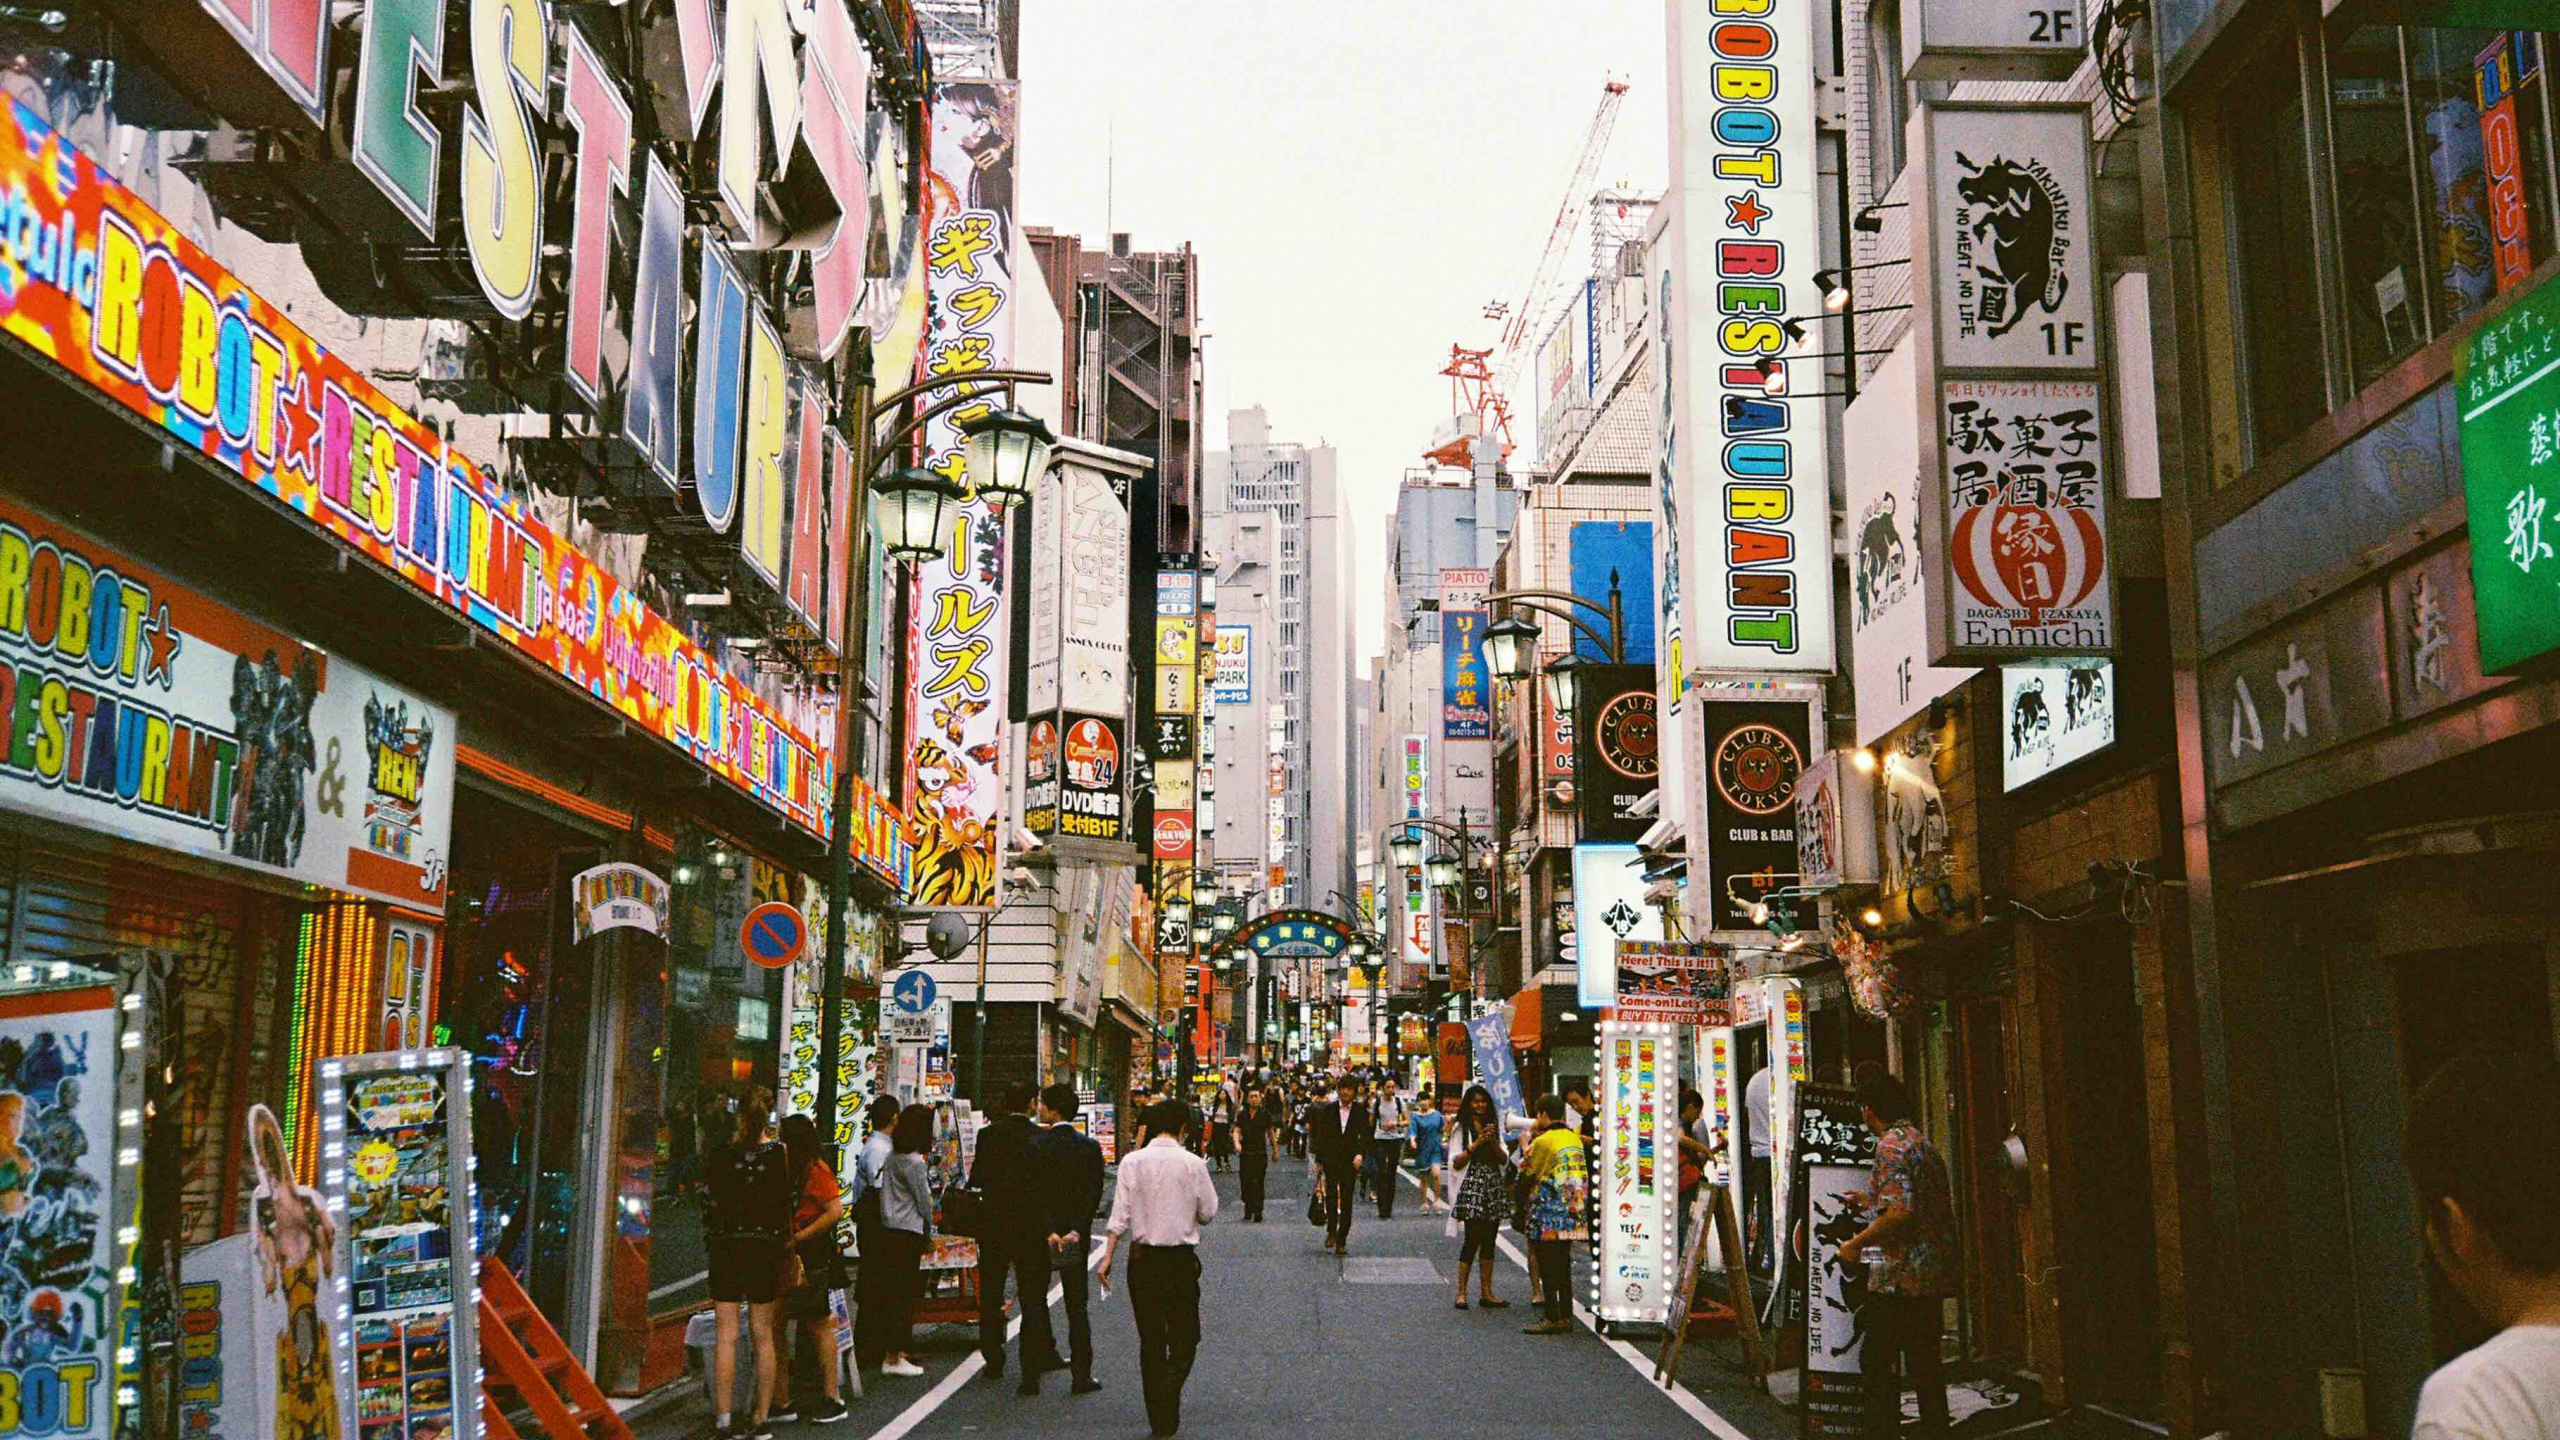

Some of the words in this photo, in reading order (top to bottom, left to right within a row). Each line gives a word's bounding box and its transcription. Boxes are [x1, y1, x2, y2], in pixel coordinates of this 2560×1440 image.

[2028, 10, 2073, 43] 2F
[1956, 207, 1970, 226] NO
[2026, 157, 2070, 231] YAKINIKU
[2051, 237, 2071, 267] Bar
[1960, 281, 1973, 299] NO
[1984, 289, 2000, 322] 2nd
[1959, 303, 1975, 339] LIFE.
[2040, 322, 2084, 355] 1F
[92, 206, 287, 470] ROBOT
[320, 379, 543, 640] RESTAURANT
[1946, 400, 2098, 459] 駄菓子
[1716, 238, 1799, 654] RESTAURANT
[1113, 478, 1127, 495] 2F
[1951, 460, 2099, 510] 居酒屋
[1444, 572, 1485, 583] PIATTO
[0, 520, 151, 687] ROBOT
[1966, 607, 2031, 620] DAGASHI
[2039, 608, 2102, 620] IZAKAYA
[1965, 619, 2106, 647] Ennichi
[674, 649, 731, 763] ROBOT
[317, 736, 346, 820] &
[376, 739, 419, 804] REN
[1062, 789, 1120, 817] DVD鑑賞
[1726, 781, 1793, 809] TOKYO
[1061, 814, 1120, 838] 受付B1F
[1406, 739, 1423, 911] RESTAUNT
[1729, 828, 1758, 842] CLUB
[1761, 829, 1769, 841] &
[1771, 829, 1794, 842] BAR
[419, 848, 445, 893] 3F
[1751, 865, 1775, 888] B1
[1620, 955, 1653, 966] Here!
[1656, 956, 1682, 967] This
[1684, 957, 1694, 968] is
[893, 1028, 931, 1037] 一方通行
[1621, 1011, 1641, 1021] BUY
[1643, 1011, 1660, 1021] THE
[1661, 1012, 1698, 1023] TICKETS
[1637, 1039, 1655, 1092] ROBOT
[1637, 1103, 1655, 1196] RESTAURANT
[1811, 1247, 1822, 1263] NO
[1810, 1307, 1822, 1323] NO
[180, 1279, 222, 1404] ROBOT
